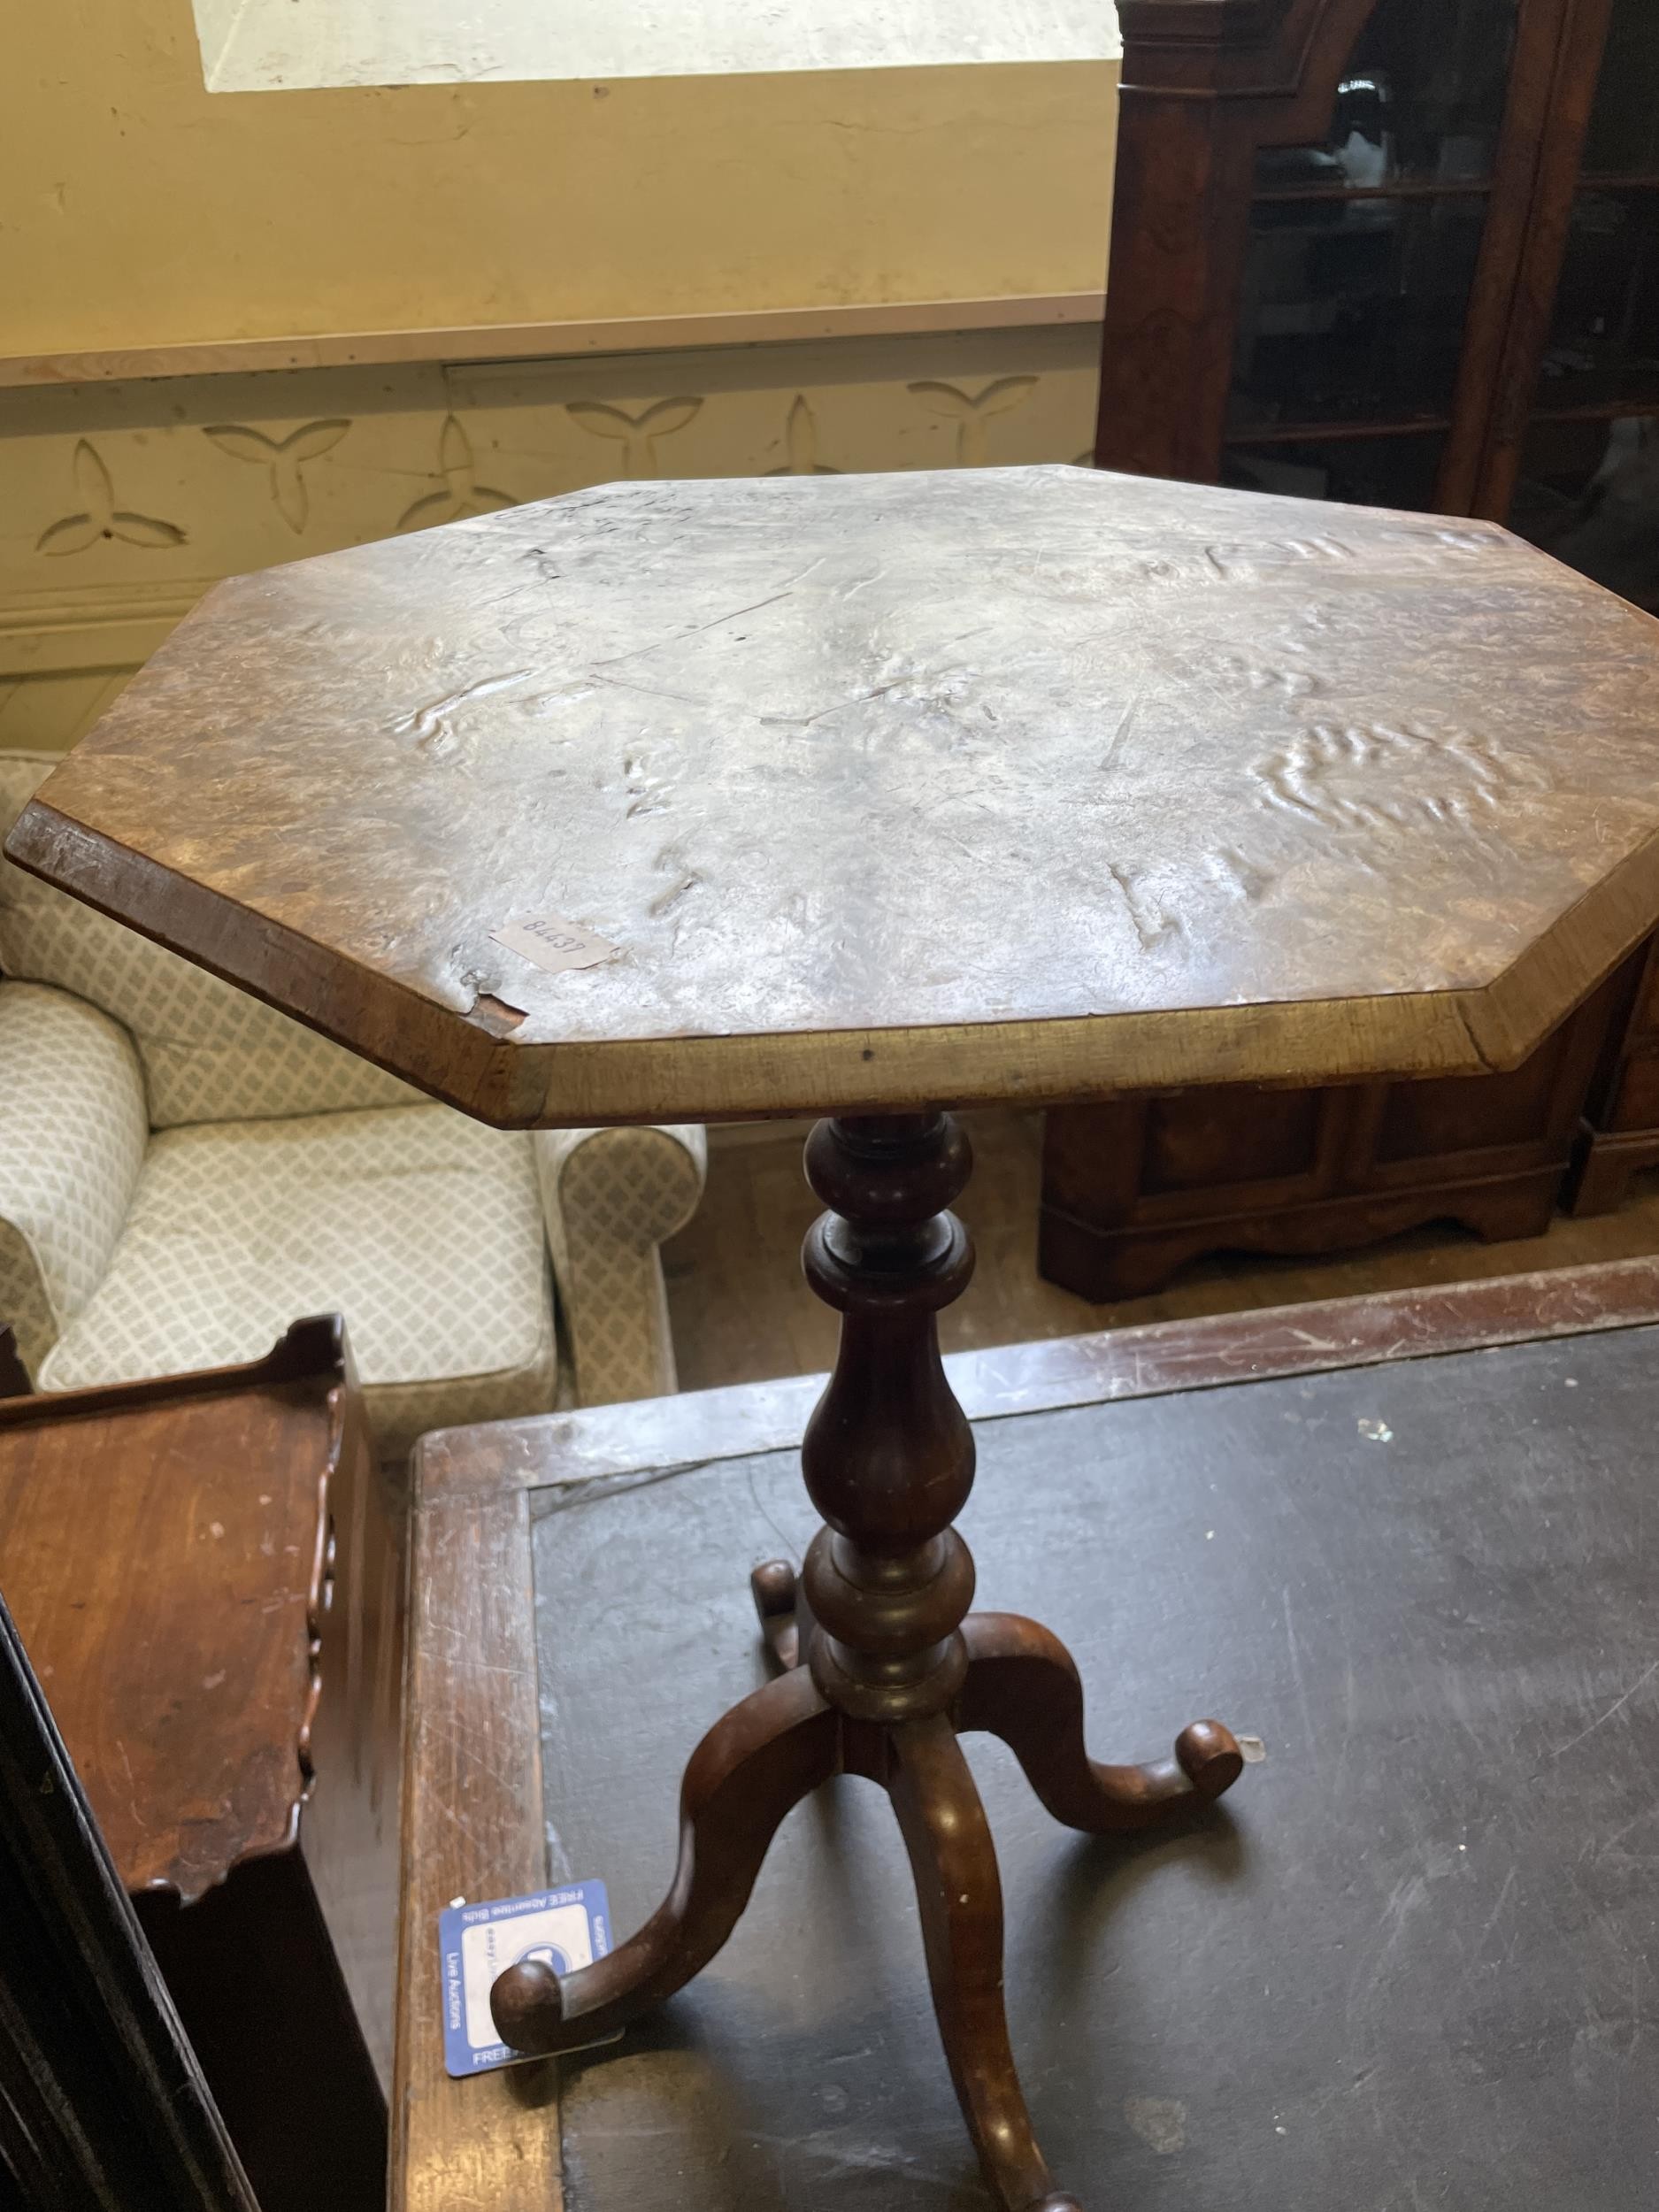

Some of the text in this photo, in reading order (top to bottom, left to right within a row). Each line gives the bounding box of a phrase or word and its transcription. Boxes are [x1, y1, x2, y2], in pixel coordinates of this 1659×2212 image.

[523, 920, 586, 954] 84437
[549, 1889, 584, 1906] FREE
[446, 1952, 462, 2030] Live Auctions
